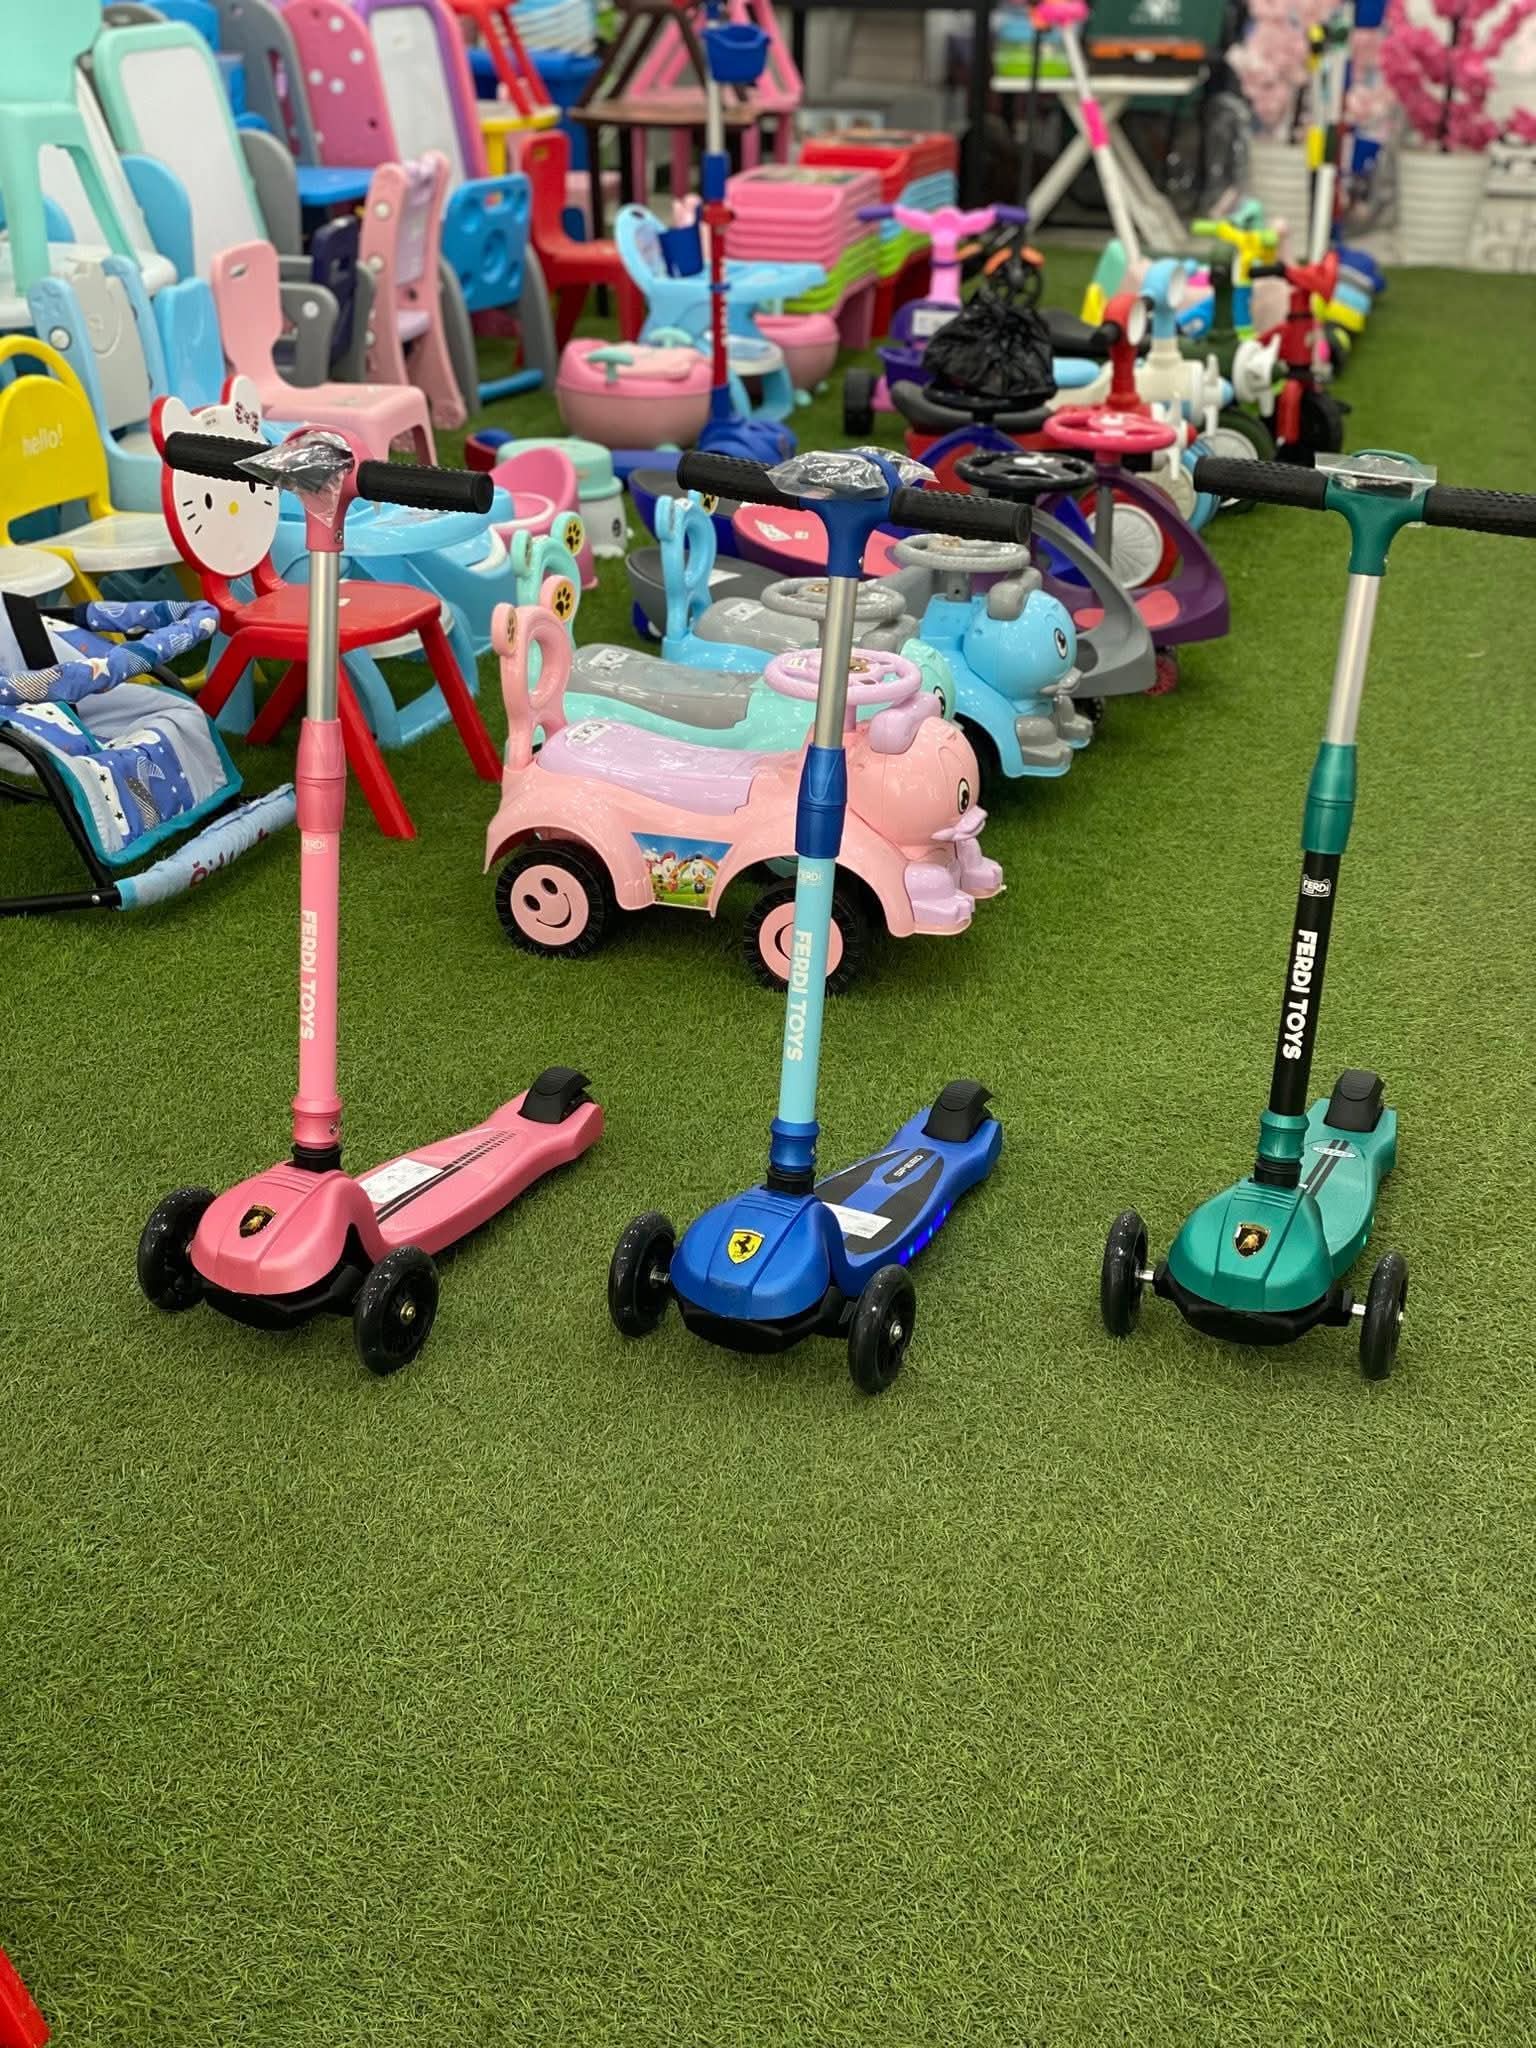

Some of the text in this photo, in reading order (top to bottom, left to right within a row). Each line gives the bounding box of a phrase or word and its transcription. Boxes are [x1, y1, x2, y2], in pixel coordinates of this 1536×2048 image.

[300, 909, 318, 1040] FERDI TOYS
[786, 930, 812, 1061] FERDI TOYS
[1282, 929, 1318, 1060] FERDI TOYS
